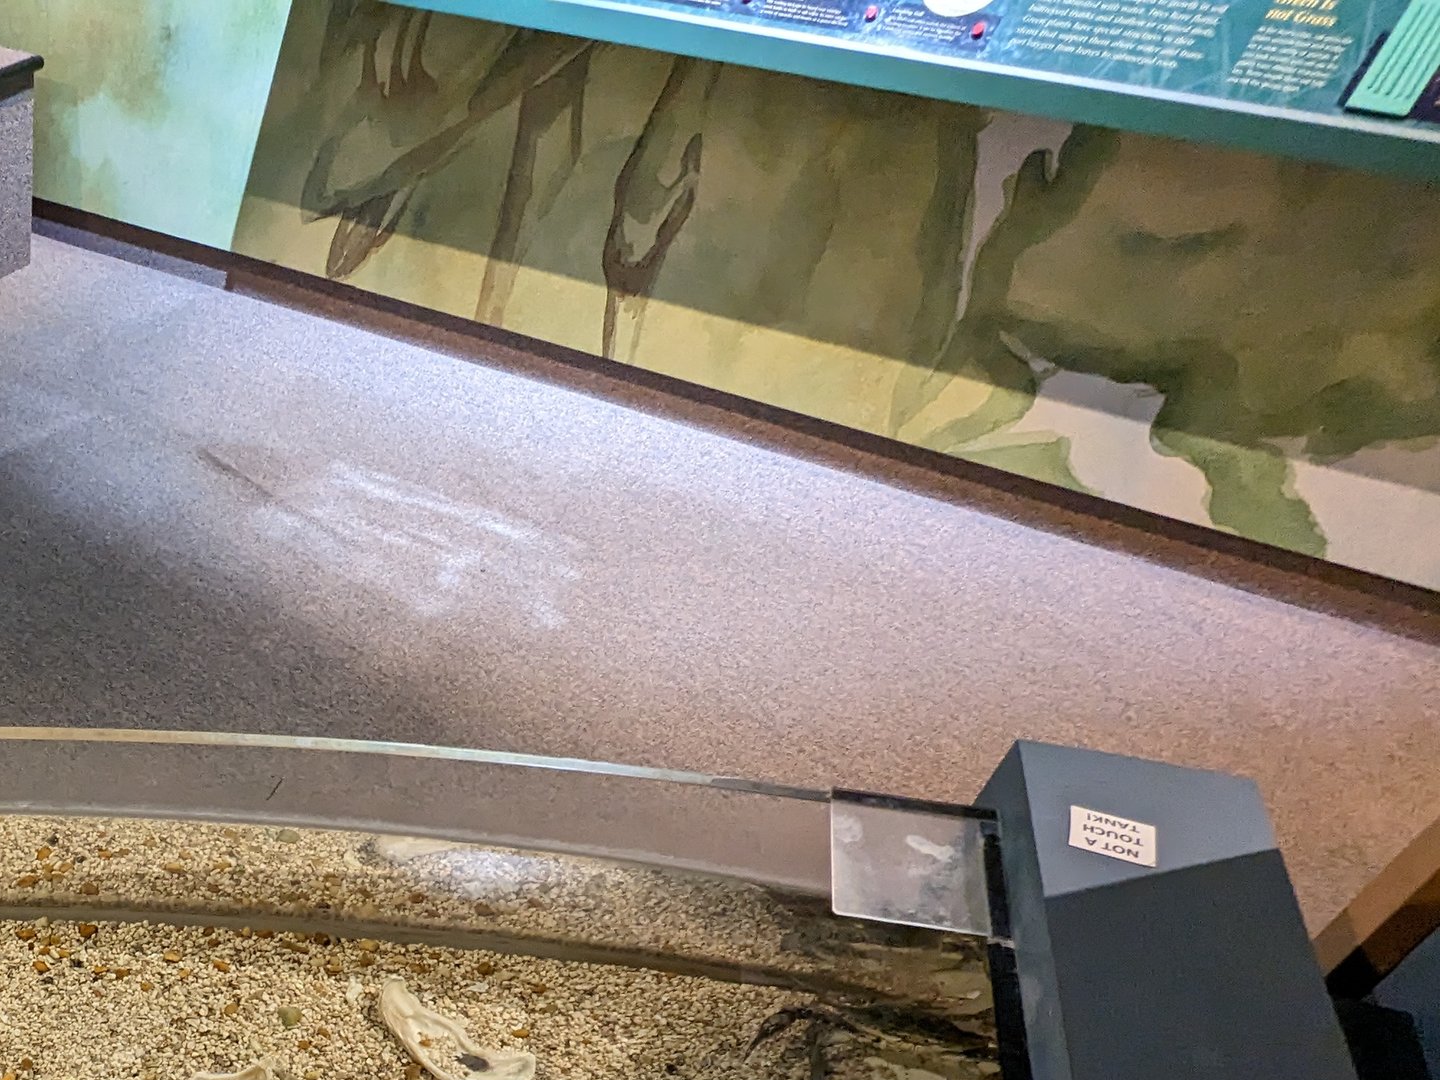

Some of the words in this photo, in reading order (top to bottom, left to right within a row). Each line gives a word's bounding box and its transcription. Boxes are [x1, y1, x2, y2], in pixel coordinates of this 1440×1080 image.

[1087, 812, 1141, 834] TANK!
[1083, 823, 1145, 847] TOUCH
[1084, 836, 1098, 847] A
[1101, 842, 1140, 859] NOT
